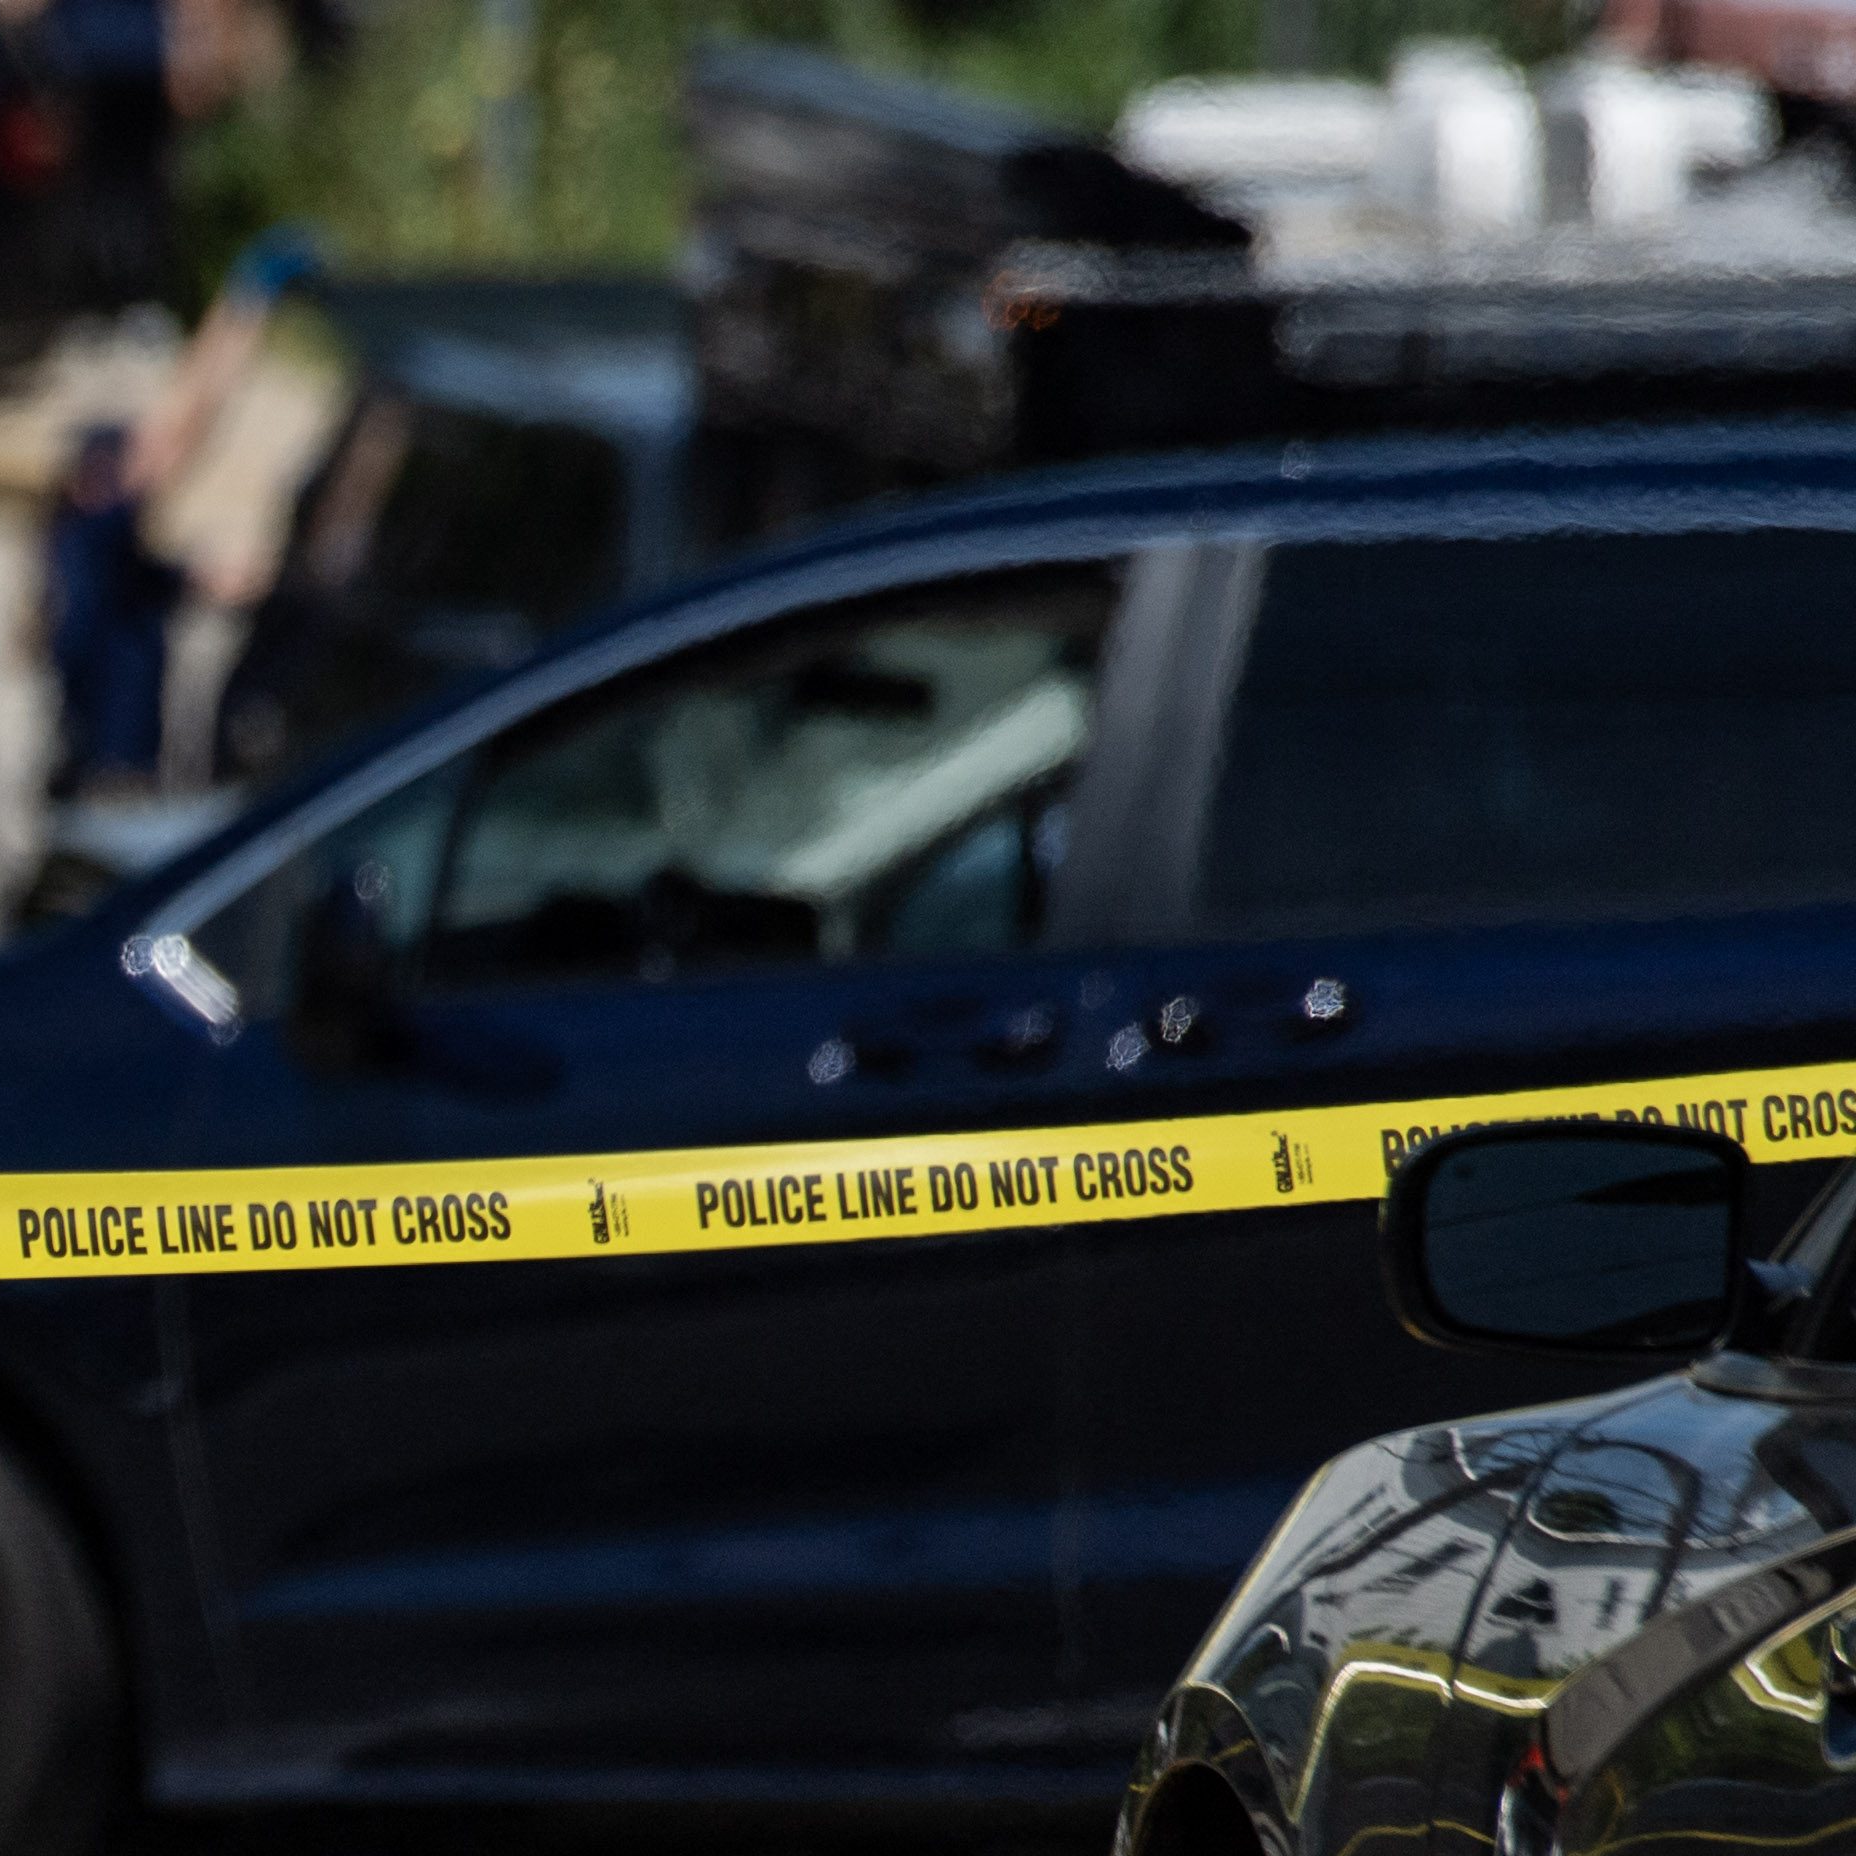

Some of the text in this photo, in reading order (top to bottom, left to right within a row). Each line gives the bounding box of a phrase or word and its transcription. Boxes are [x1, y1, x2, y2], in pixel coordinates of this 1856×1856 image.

[698, 1146, 1192, 1228] POLICE LINE DO NOT CROSS
[19, 1193, 510, 1257] POLICE LINE DO NOT CROSS
